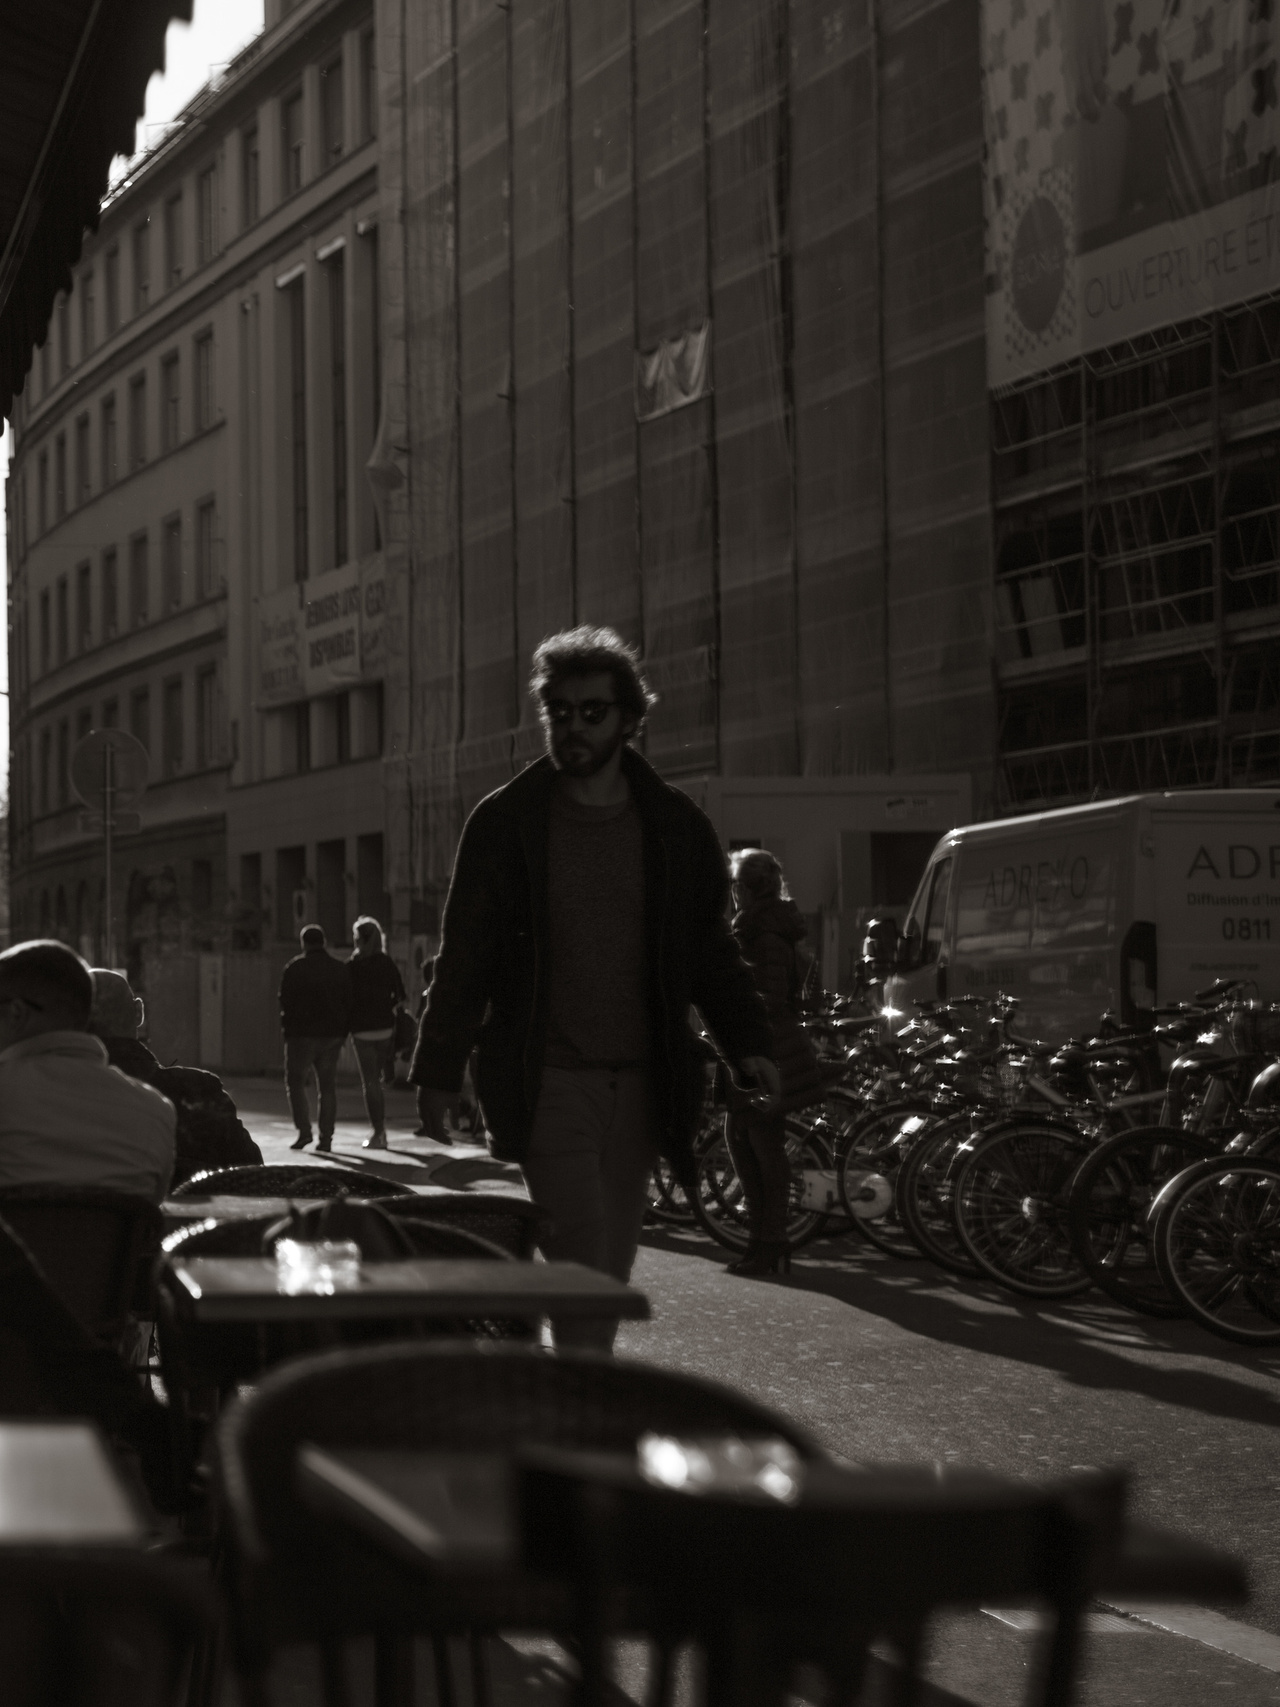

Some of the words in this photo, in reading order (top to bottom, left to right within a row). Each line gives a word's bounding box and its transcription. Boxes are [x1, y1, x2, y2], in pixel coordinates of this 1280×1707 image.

[1084, 228, 1238, 319] OUVERTURE
[1245, 211, 1280, 266] ÉT
[1187, 892, 1248, 906] Diffusion
[1222, 917, 1271, 941] 0811
